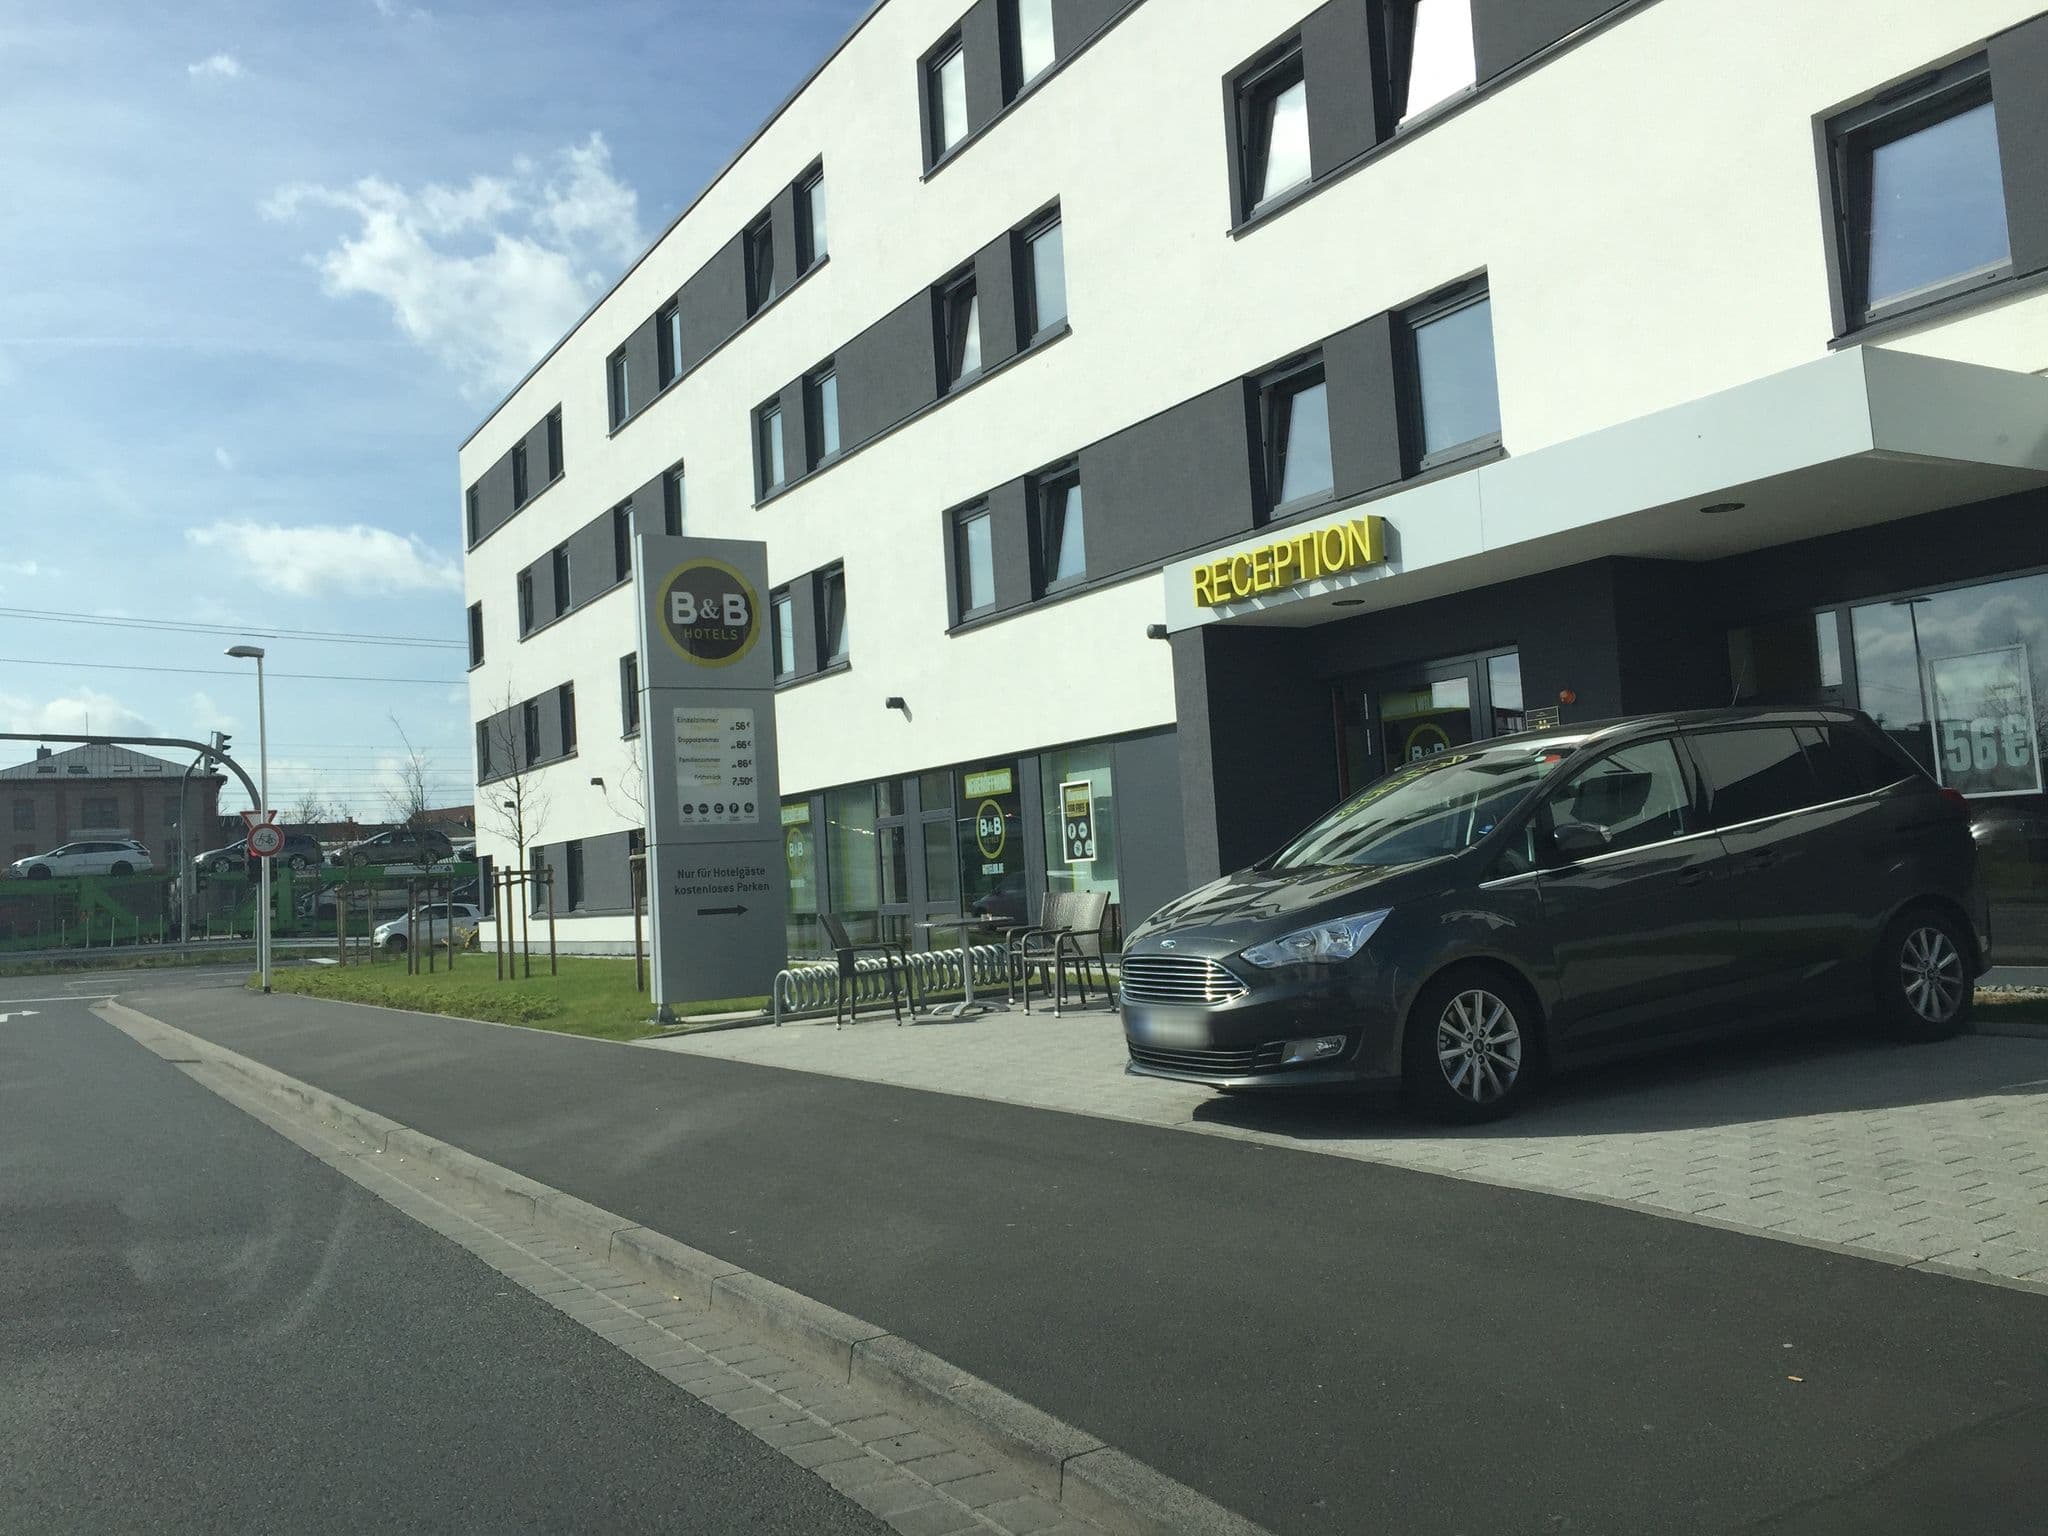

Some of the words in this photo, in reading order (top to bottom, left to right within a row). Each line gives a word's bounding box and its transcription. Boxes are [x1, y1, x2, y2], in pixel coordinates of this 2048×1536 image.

[1191, 514, 1372, 608] RECEPTION
[671, 591, 749, 626] B&B
[684, 628, 738, 640] HOTELS
[980, 816, 1002, 837] B&B
[677, 869, 695, 879] Nur
[697, 867, 711, 878] für
[713, 866, 766, 879] Hotelgäste
[674, 884, 734, 895] kostenloses
[737, 882, 770, 893] Parken
